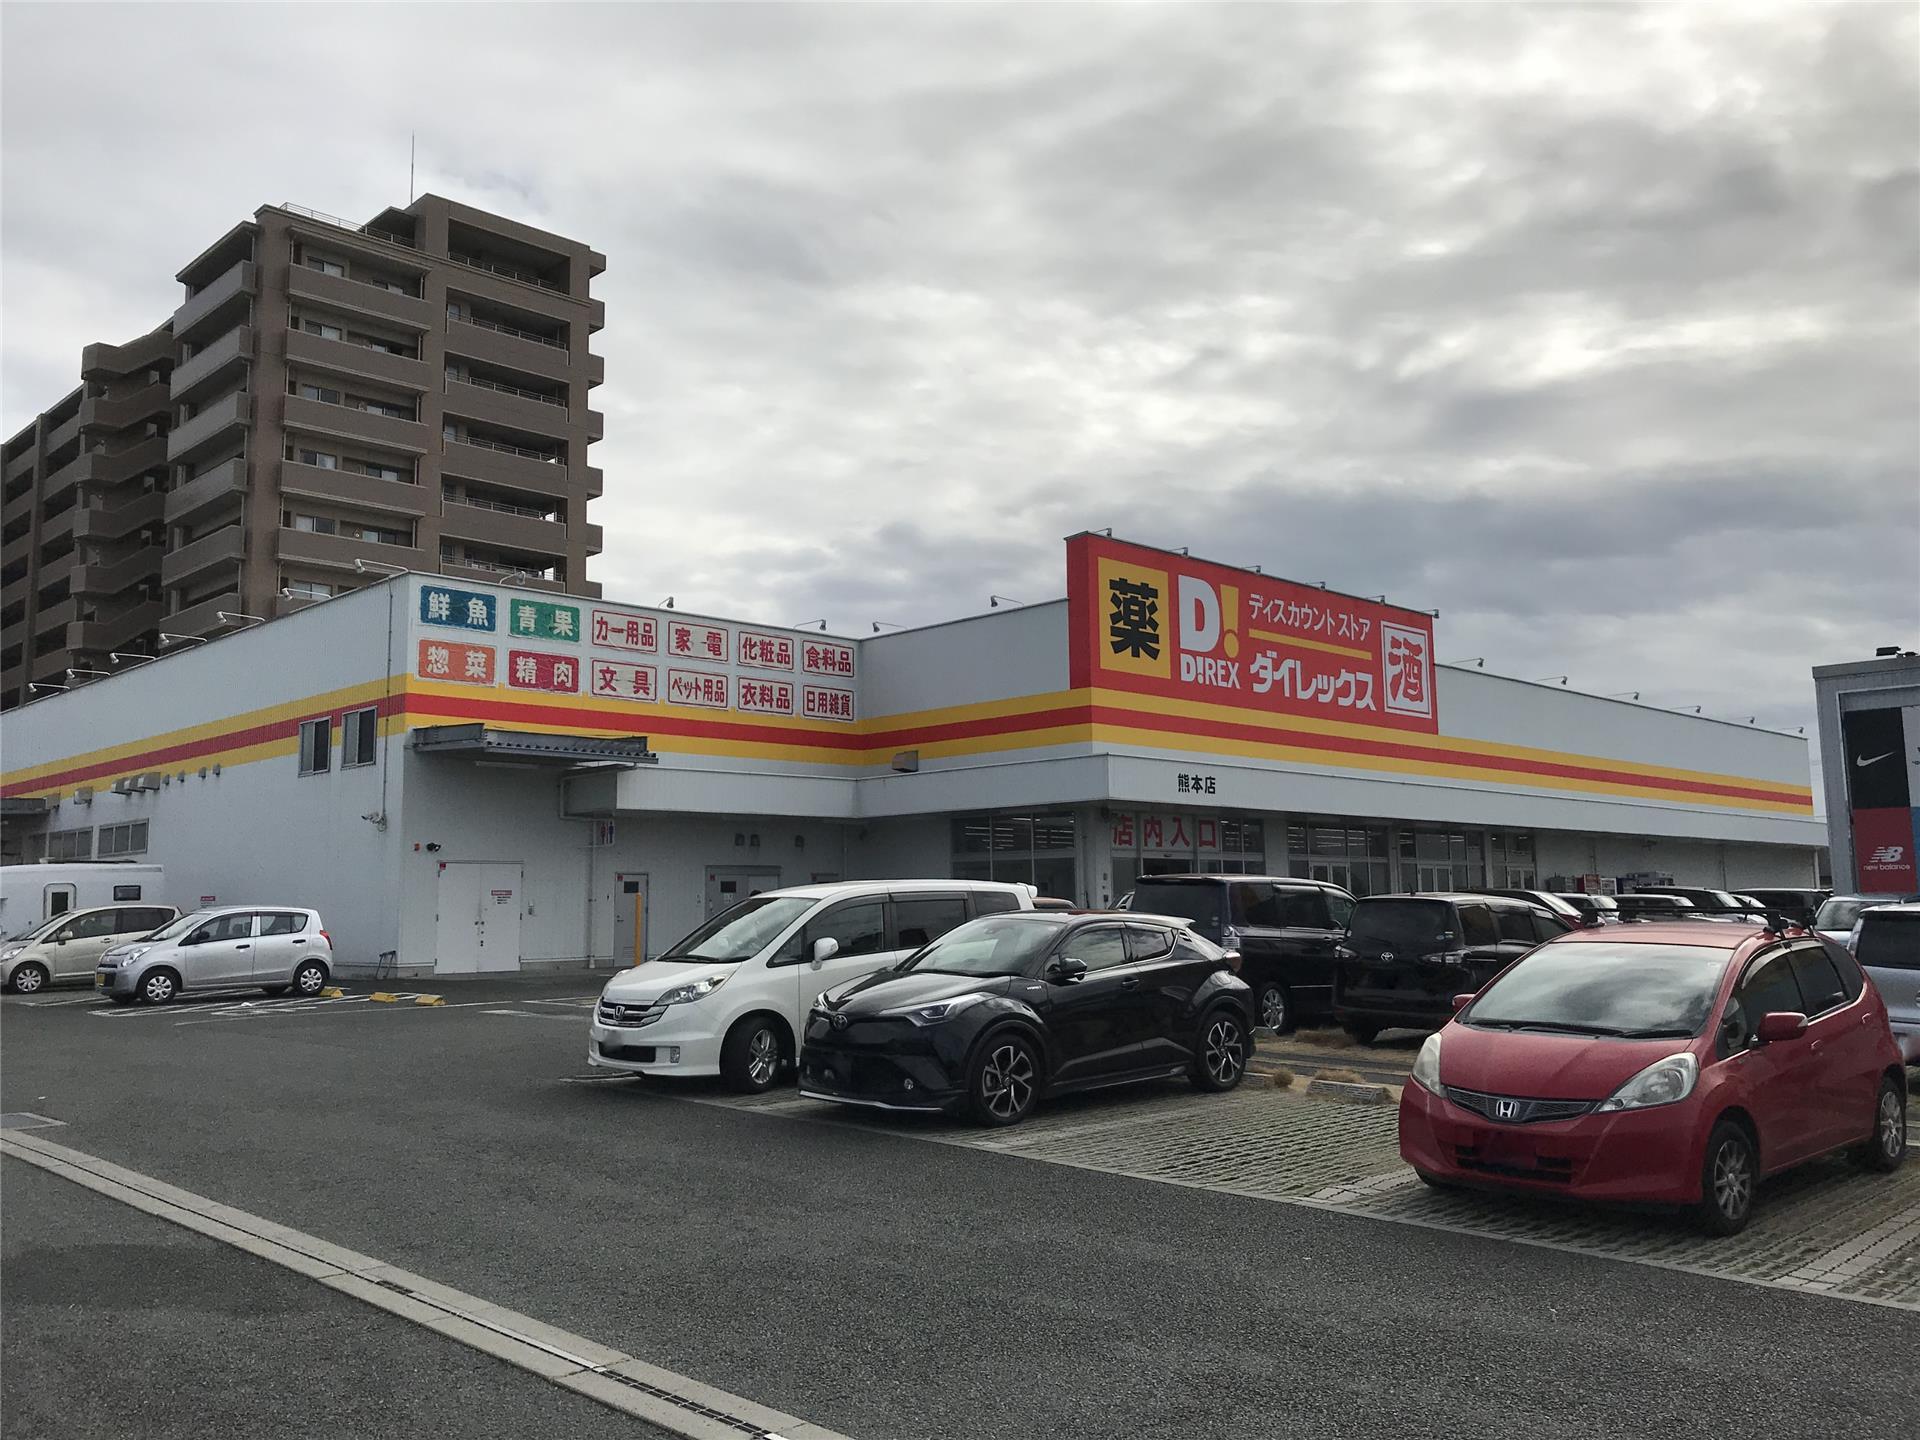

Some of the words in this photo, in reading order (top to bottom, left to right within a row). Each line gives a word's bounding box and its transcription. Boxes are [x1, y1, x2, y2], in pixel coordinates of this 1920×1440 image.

[428, 591, 489, 627] 鮮魚
[517, 605, 574, 637] 青果
[1109, 577, 1161, 660] 薬
[596, 616, 654, 647] カー用品
[674, 627, 722, 657] 家電
[427, 645, 488, 678] 惣菜
[742, 636, 791, 665] 化粧品
[806, 645, 851, 673] 食料品
[516, 655, 573, 688] 精肉
[599, 666, 650, 695] 文具
[1250, 650, 1377, 711] ダイレックス
[1390, 635, 1424, 704] 酒
[671, 677, 725, 703] ペット用品
[741, 683, 790, 709] 衣料品
[806, 690, 850, 716] 日用雑貨
[1177, 772, 1216, 795] 熊本店
[1112, 815, 1216, 848] 店内入口
